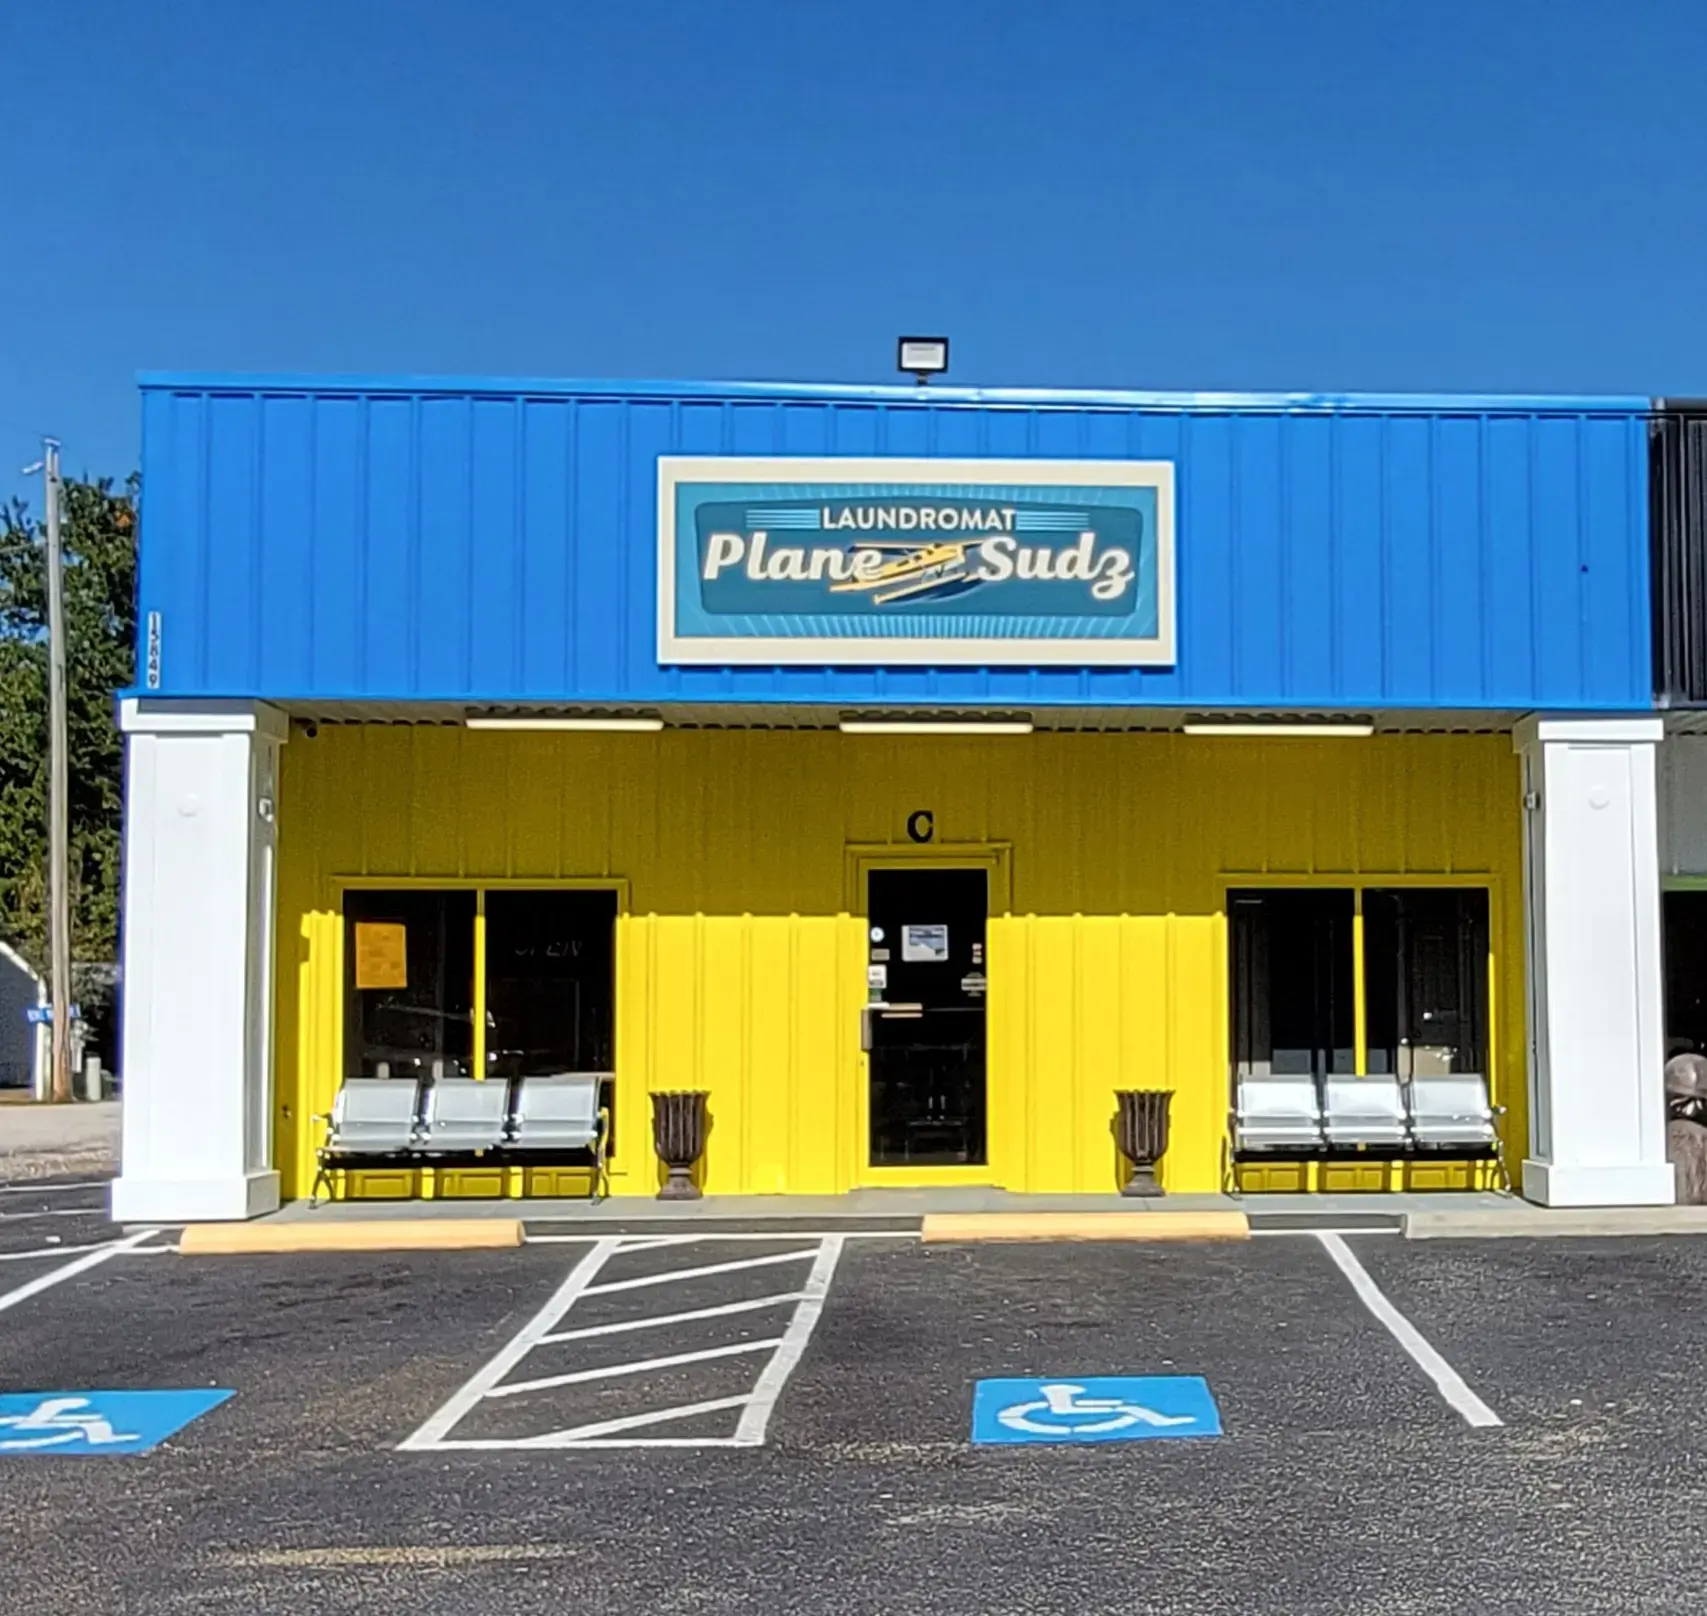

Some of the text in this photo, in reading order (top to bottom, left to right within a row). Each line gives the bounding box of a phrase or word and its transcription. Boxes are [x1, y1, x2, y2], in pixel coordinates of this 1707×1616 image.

[822, 506, 1017, 532] LAUNDROMAT
[703, 531, 1135, 600] Plane Sudz
[907, 810, 934, 843] C
